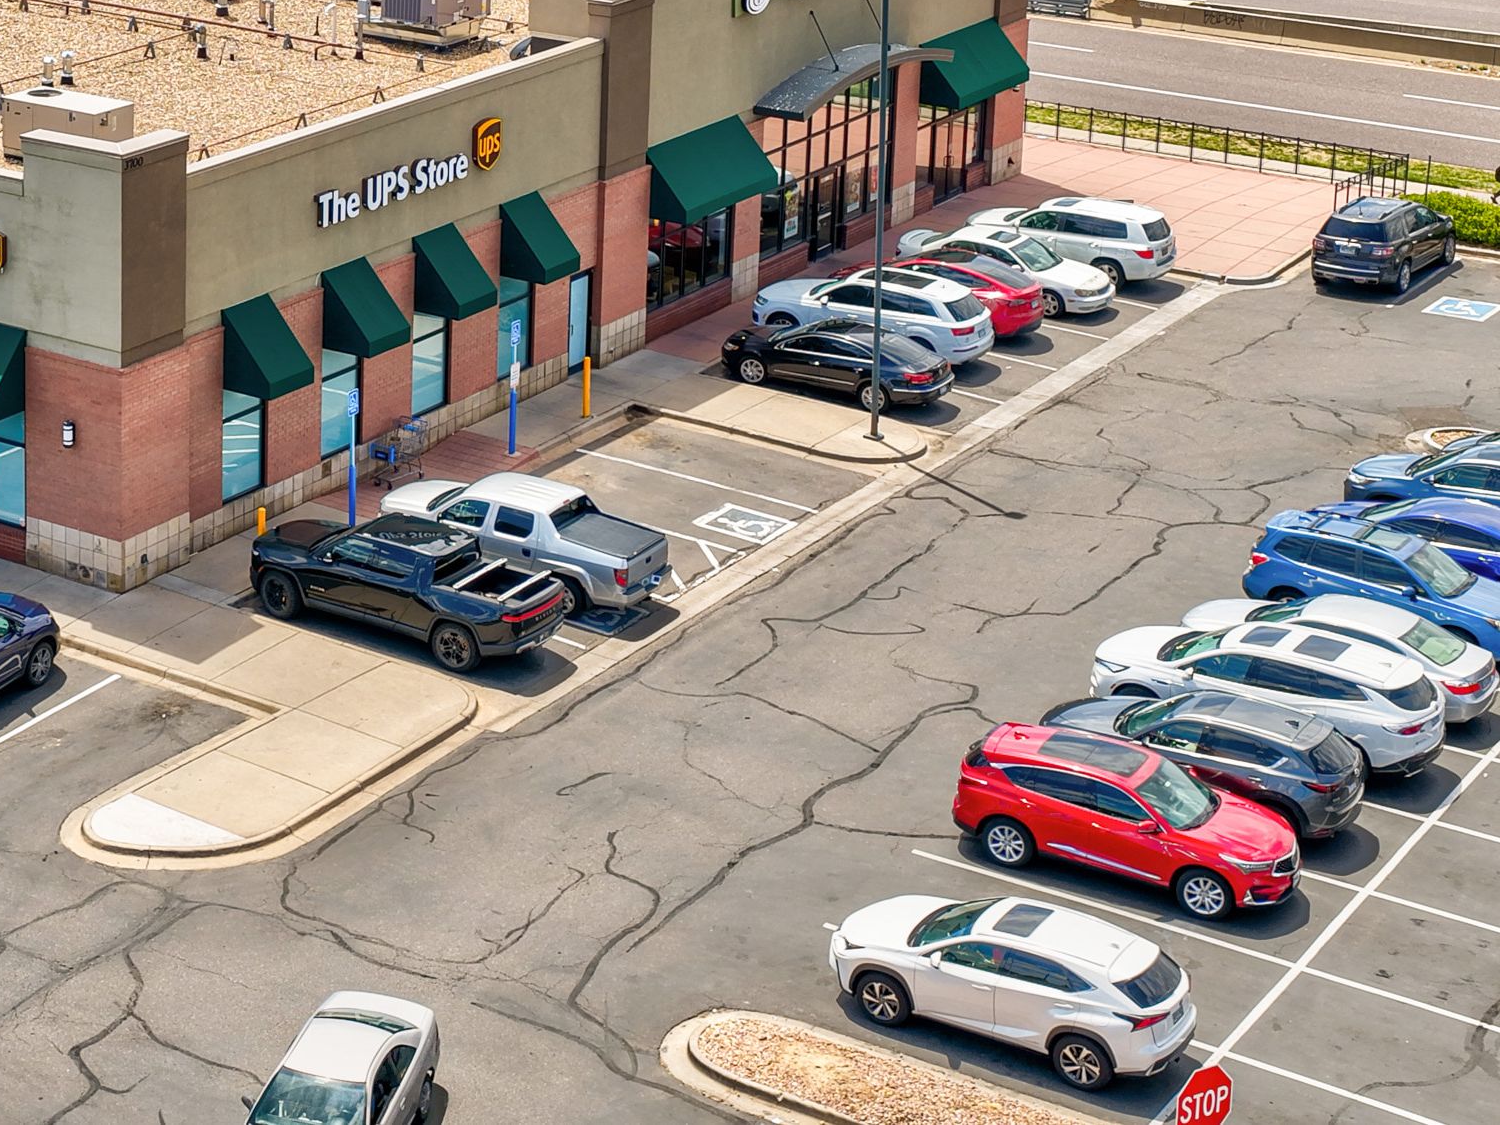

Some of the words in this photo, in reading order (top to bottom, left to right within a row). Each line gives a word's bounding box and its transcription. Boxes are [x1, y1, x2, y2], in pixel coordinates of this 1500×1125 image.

[479, 132, 500, 163] ups
[318, 189, 361, 229] The
[367, 165, 410, 211] UPS
[414, 154, 469, 195] Store
[1180, 1085, 1230, 1125] STOP
